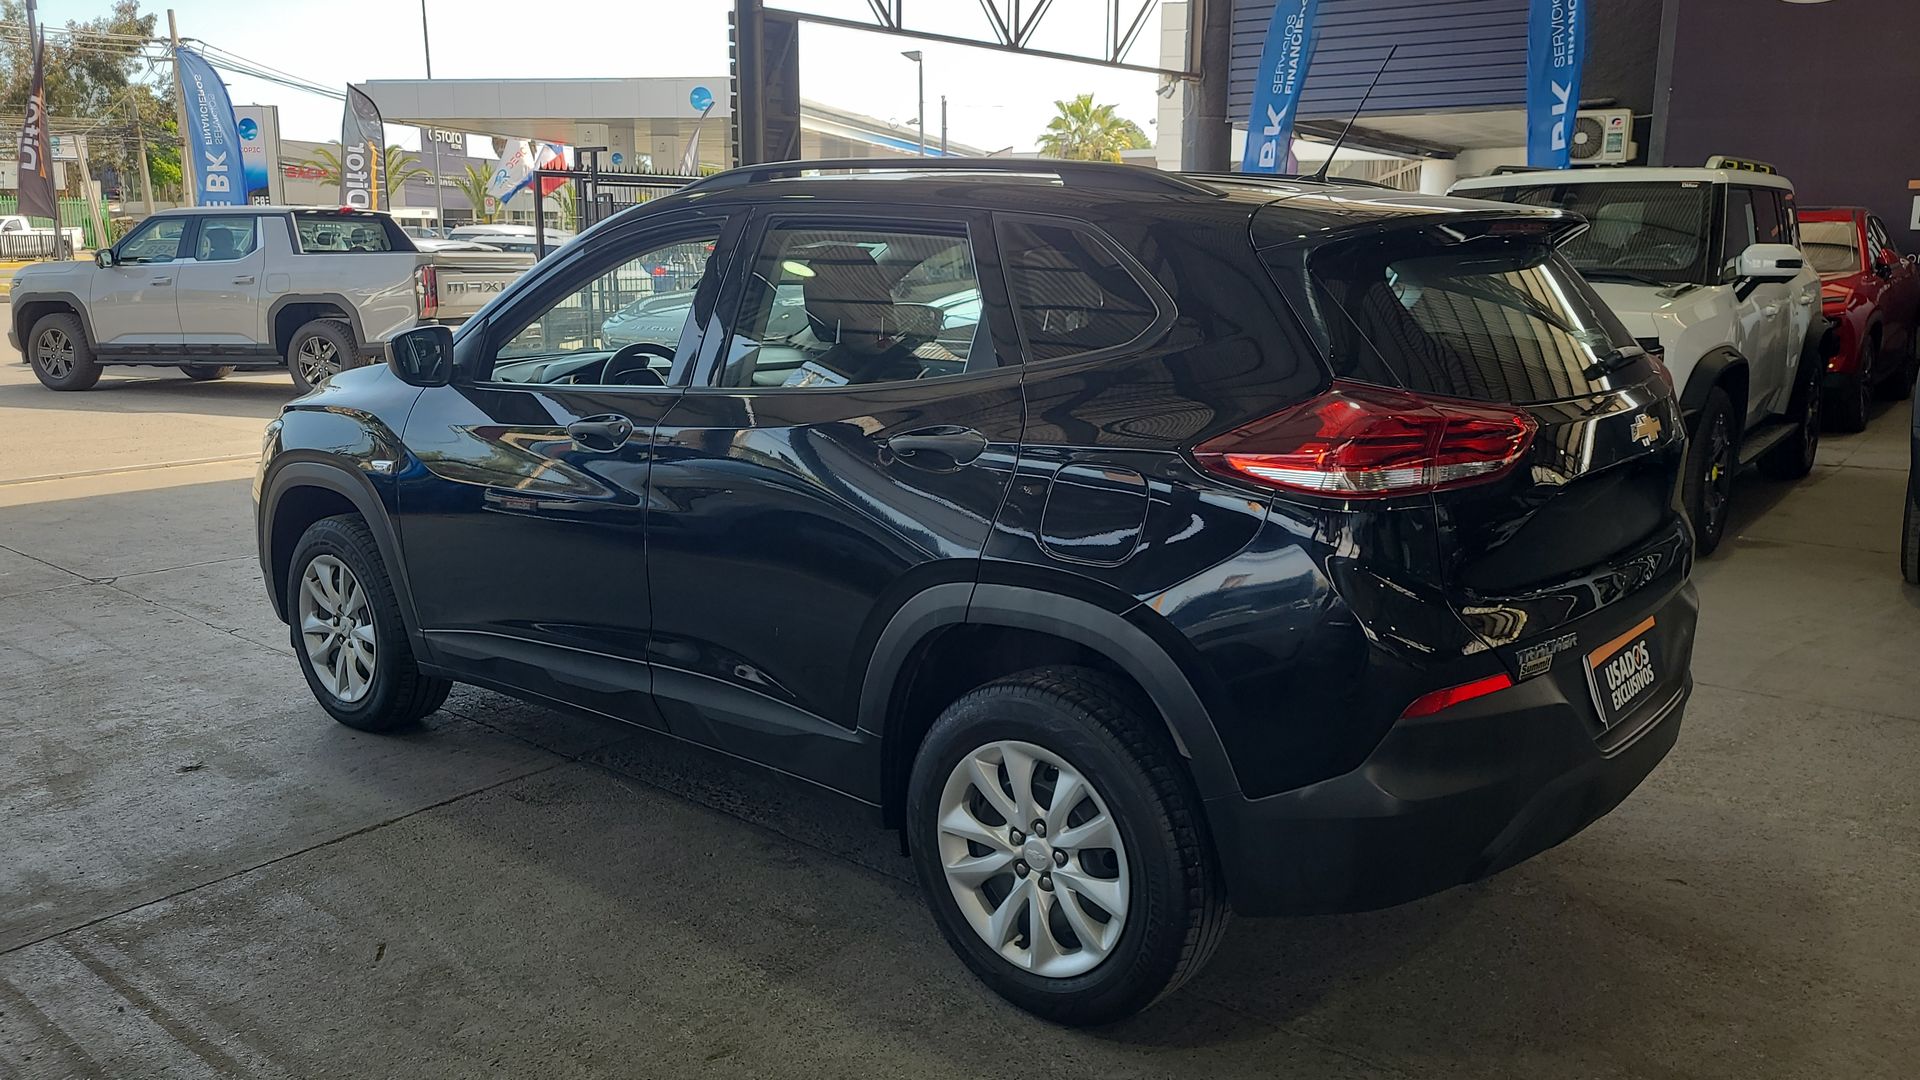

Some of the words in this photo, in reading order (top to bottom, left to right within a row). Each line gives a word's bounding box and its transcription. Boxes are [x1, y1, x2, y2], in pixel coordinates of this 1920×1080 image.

[1273, 14, 1297, 94] SERVICIOS
[1259, 104, 1289, 168] BK
[1604, 640, 1650, 691] USADOS
[1611, 663, 1655, 711] EXCLUSIVOS
